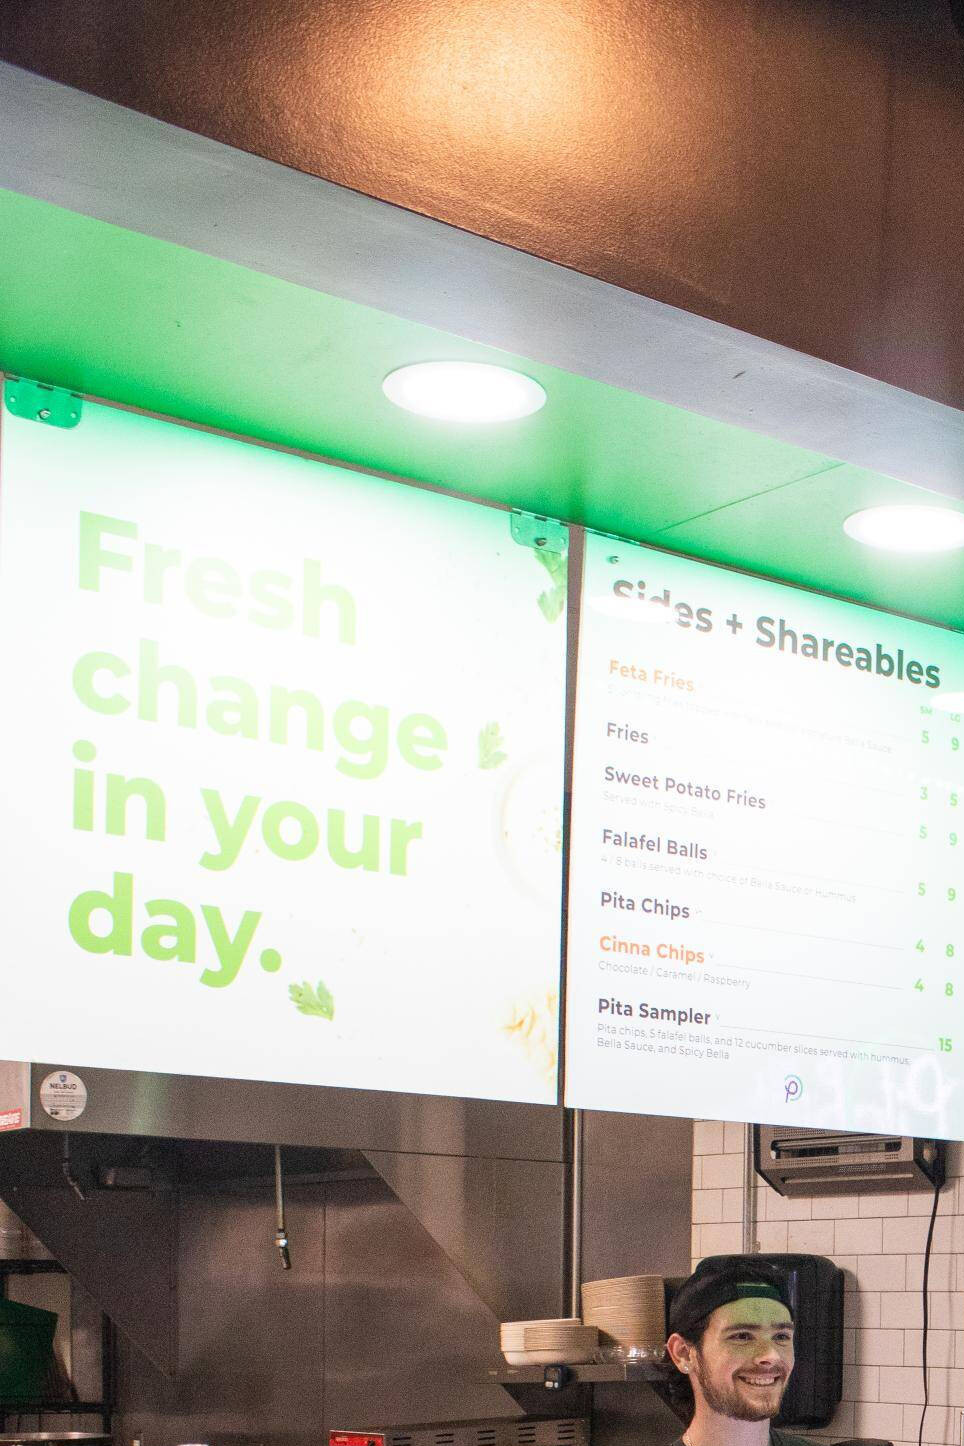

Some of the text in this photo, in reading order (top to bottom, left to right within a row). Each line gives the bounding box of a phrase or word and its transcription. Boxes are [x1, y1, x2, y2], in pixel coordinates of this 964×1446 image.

[78, 510, 358, 646] Fresh
[726, 614, 743, 635] +
[756, 616, 941, 688] Shareables
[609, 659, 695, 693] Feta Fries
[72, 638, 449, 780] change
[607, 722, 649, 744] Fries
[921, 730, 960, 751] 5 9
[604, 766, 766, 809] Sweet Potato Fries
[949, 793, 958, 807] 5
[72, 739, 423, 877] in your
[602, 828, 708, 860] Falafel Balls
[949, 832, 957, 847] 9
[601, 891, 690, 919] Pita Chips
[917, 882, 956, 902] 5 9
[68, 871, 282, 989] day.
[600, 936, 705, 965] Cinna Chips
[916, 940, 954, 958] 4 8
[598, 960, 750, 990] Chocolate Caramel Raspberry
[915, 978, 954, 996] 4 8
[598, 998, 711, 1026] Pita Sampler
[597, 1023, 617, 1036] Pita
[657, 1029, 686, 1043] falafel
[714, 1034, 733, 1046] and
[734, 1037, 744, 1048] 12
[745, 1038, 792, 1054] cucumber
[794, 1043, 817, 1056] slices
[819, 1046, 848, 1059] served
[597, 1037, 622, 1050] Bella
[658, 1042, 677, 1055] and
[679, 1045, 704, 1060] Spicy
[706, 1047, 730, 1060] Bella
[938, 1037, 952, 1052] 15
